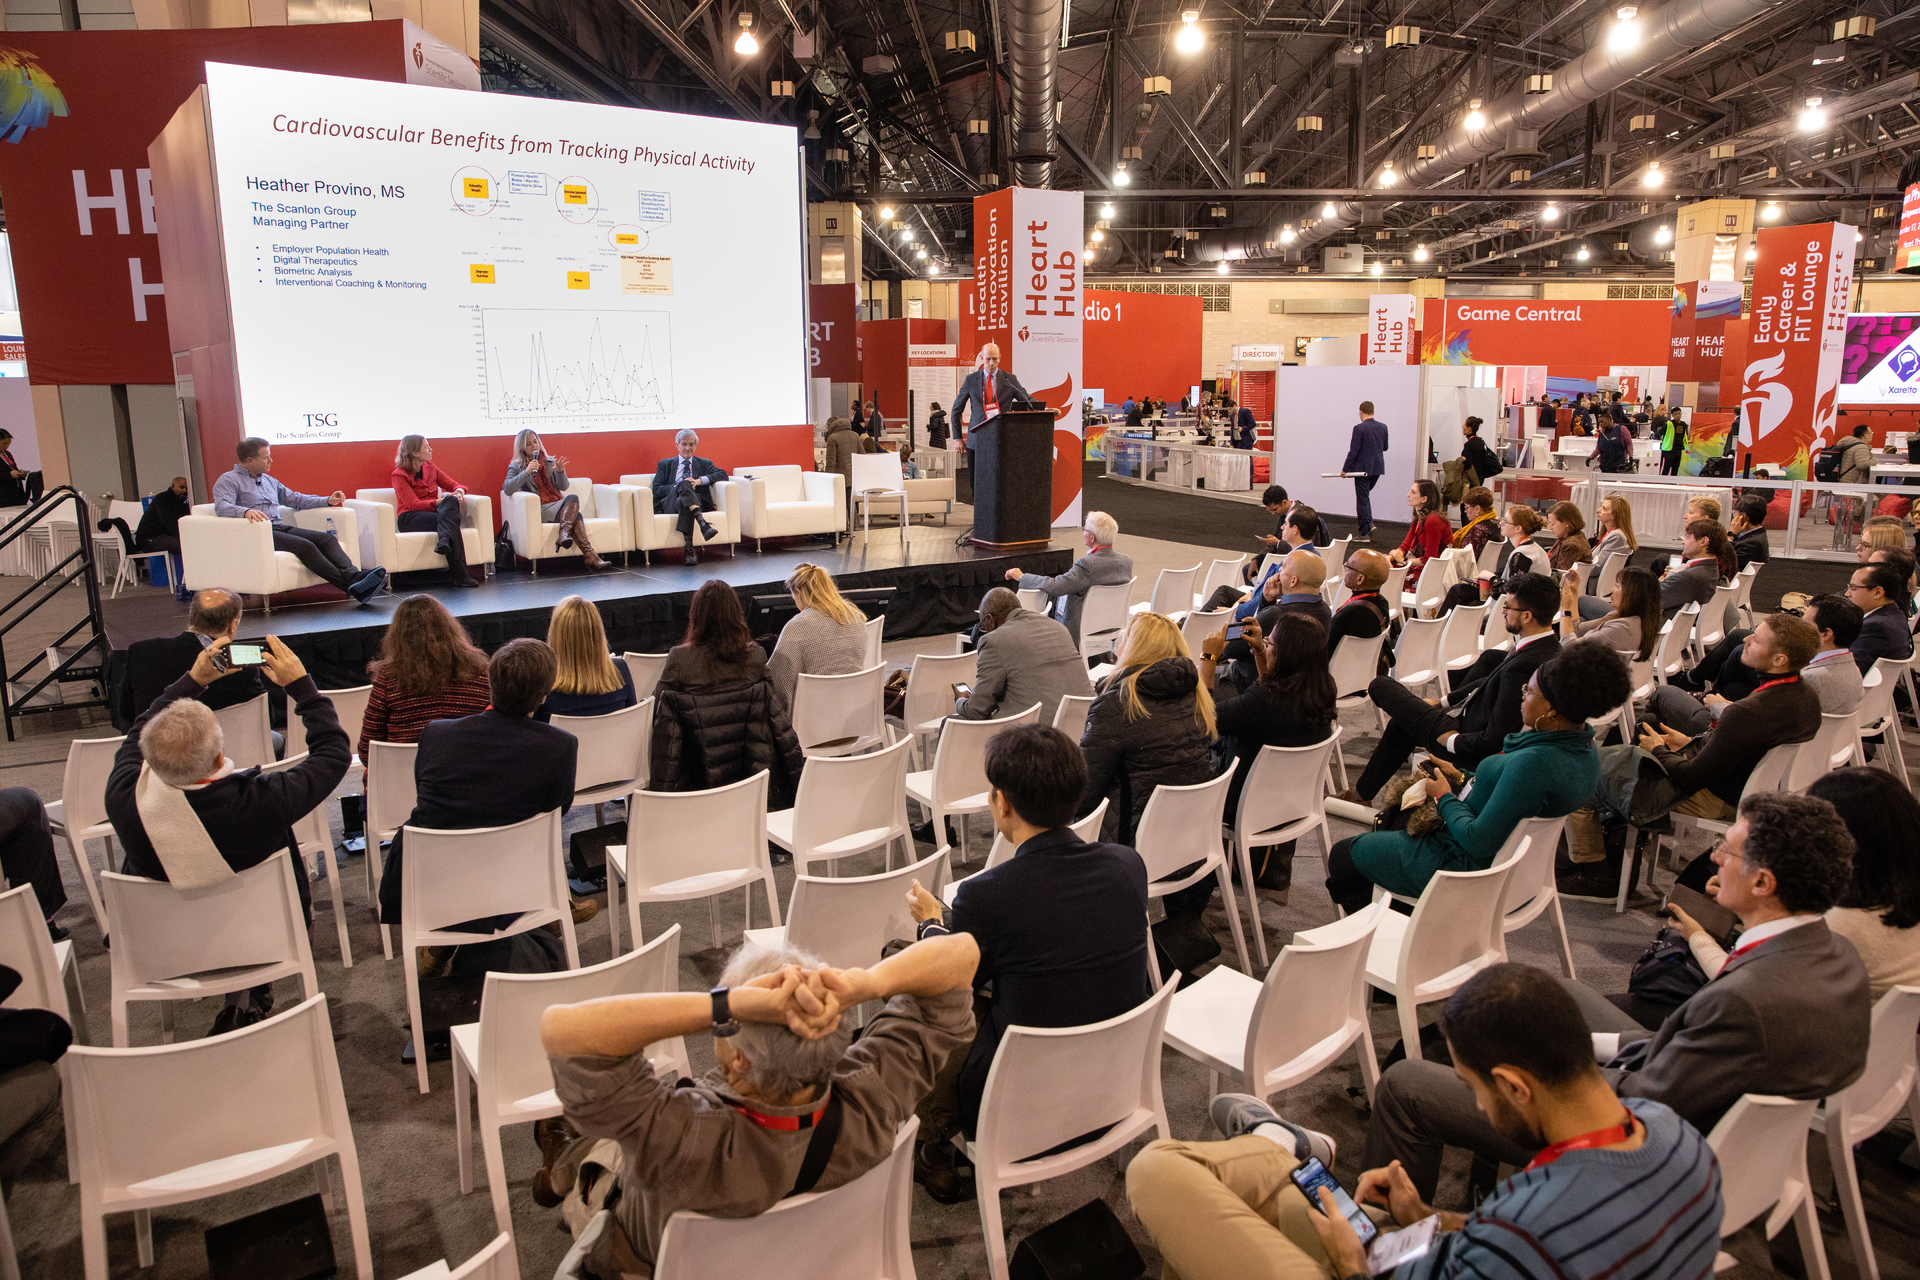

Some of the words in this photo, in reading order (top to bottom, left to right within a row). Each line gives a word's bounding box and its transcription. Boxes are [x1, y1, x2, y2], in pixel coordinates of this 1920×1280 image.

[272, 114, 426, 144] Cardiovascular
[431, 128, 506, 153] Benefits
[508, 134, 553, 155] from
[558, 139, 629, 164] Tracking
[633, 146, 697, 167] Physical
[699, 153, 756, 175] Activity
[246, 175, 310, 193] Heather
[314, 180, 376, 199] Provino,
[381, 184, 405, 199] MS
[251, 201, 274, 212] The
[276, 203, 321, 215] Scanlon
[323, 205, 357, 218] Group
[253, 216, 307, 230] Managing
[310, 218, 350, 229] Partner
[272, 244, 314, 255] Employer
[315, 245, 361, 256] Population
[362, 247, 390, 256] Health
[273, 255, 301, 265] Digital
[303, 256, 358, 266] Therapeutics
[274, 266, 315, 276] Biometric
[317, 267, 353, 278] Analysis
[988, 208, 997, 330] Innovation
[1025, 220, 1048, 316] Heart
[1780, 261, 1797, 277] &
[1796, 240, 1823, 311] Lounge
[275, 277, 334, 287] Interventional
[335, 279, 375, 289] Coaching
[376, 280, 383, 288] &
[385, 280, 427, 291] Monitoring
[977, 256, 987, 331] Health
[998, 239, 1008, 329] Pavilion
[1053, 250, 1076, 317] Hub
[1827, 250, 1844, 331] Heart
[1083, 300, 1111, 321] dio
[1114, 302, 1121, 322] 1
[1457, 305, 1511, 321] Game
[1515, 305, 1582, 321] Central
[1774, 281, 1795, 343] Career
[1836, 275, 1850, 331] Hub
[1373, 308, 1388, 353] Heart
[1753, 296, 1778, 344] Early
[1793, 315, 1812, 342] FIT
[1031, 335, 1056, 343] Scientific
[1389, 321, 1403, 353] Hub
[1671, 336, 1690, 347] HEART
[4, 353, 27, 361] SALES
[1672, 348, 1686, 358] HUB
[1888, 386, 1918, 394] Xarelto
[303, 412, 338, 428] TSG
[318, 431, 342, 439] Group
